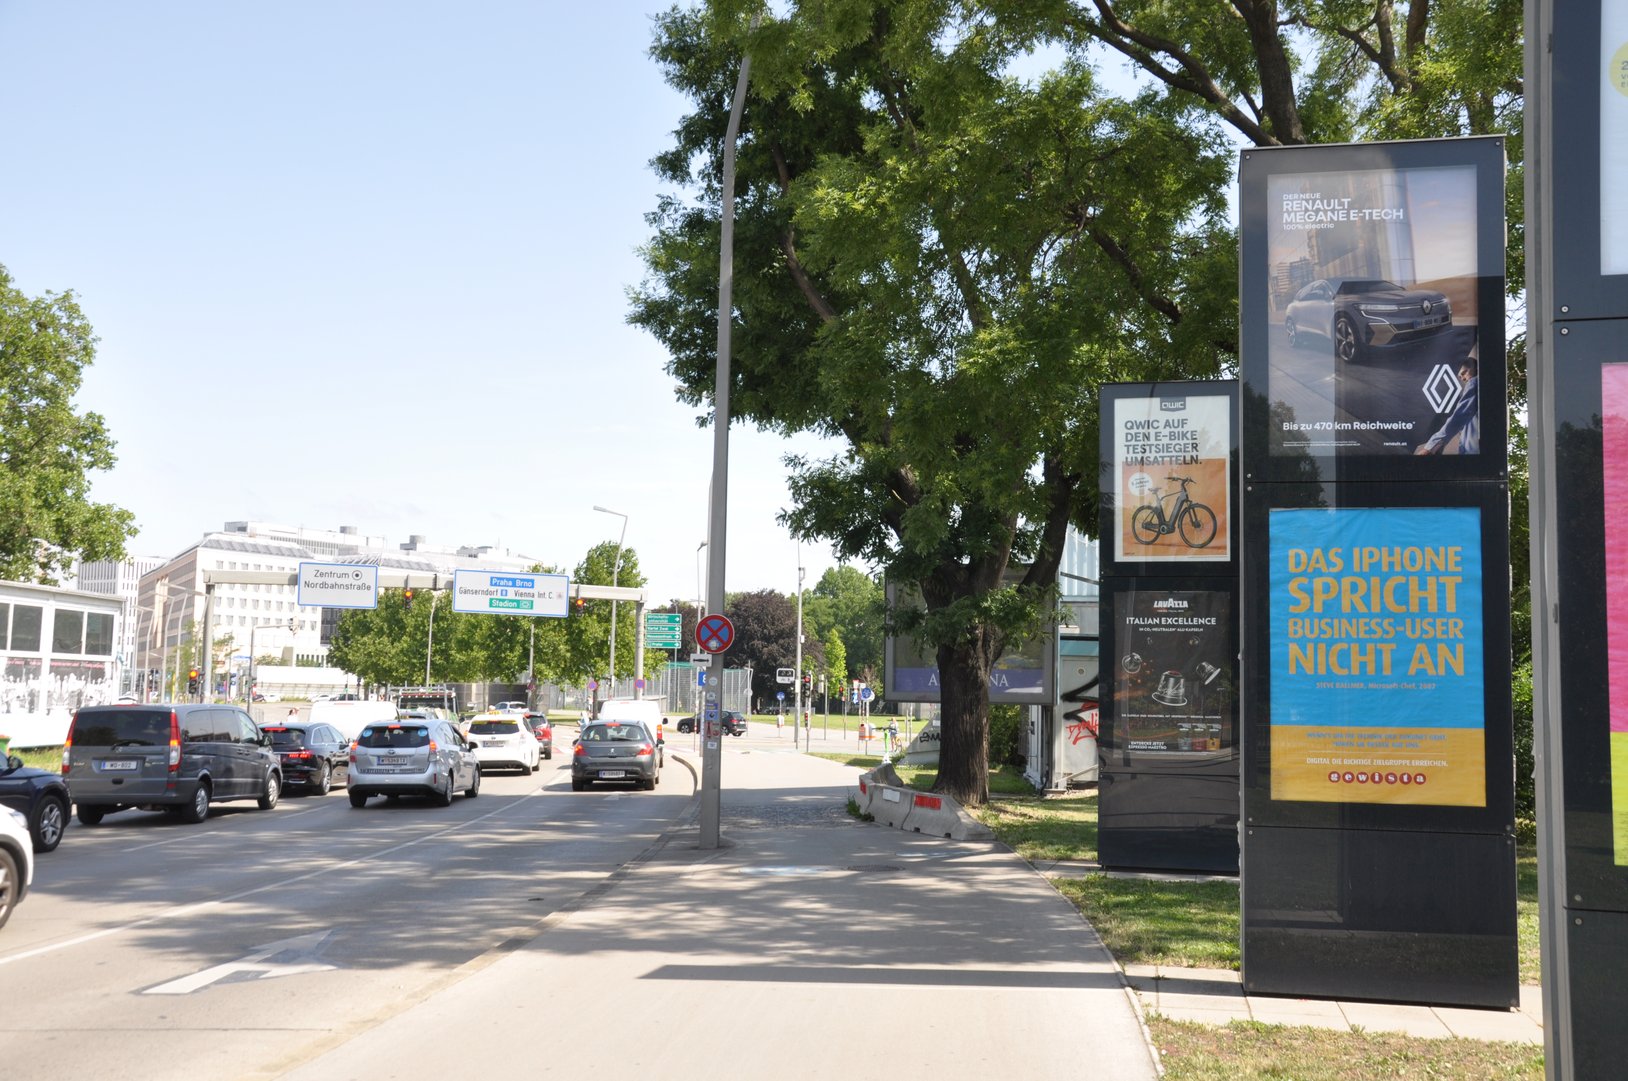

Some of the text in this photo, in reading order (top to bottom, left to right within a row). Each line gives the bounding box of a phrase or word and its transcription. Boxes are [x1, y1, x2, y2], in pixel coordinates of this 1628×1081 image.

[1283, 198, 1351, 212] RENAULT
[1283, 208, 1403, 223] MEGANE E-TECH
[1124, 418, 1188, 430] QWIC AUF
[1283, 422, 1298, 430] Bis
[1313, 421, 1333, 430] 470
[1334, 421, 1351, 429] km
[1125, 430, 1198, 442] DEN E-BIKE
[1124, 442, 1199, 454] TESTSIEGER
[1125, 454, 1202, 466] UMSATTELN.
[1288, 546, 1463, 573] DAS IPHONE
[314, 569, 350, 579] Zentrum
[304, 580, 371, 591] Nordbahnstraße
[491, 578, 533, 587] Praha Brno
[514, 589, 535, 599] Vienna
[1288, 576, 1463, 613] SPRICHT
[491, 600, 518, 608] Stadion
[1153, 598, 1189, 608] LAVAZZA
[1126, 617, 1217, 625] ITALIAN EXCELLENCE
[1288, 617, 1464, 639] BUSINESS-USER
[1288, 642, 1465, 676] NICHT AN
[1329, 772, 1426, 784] gewista
